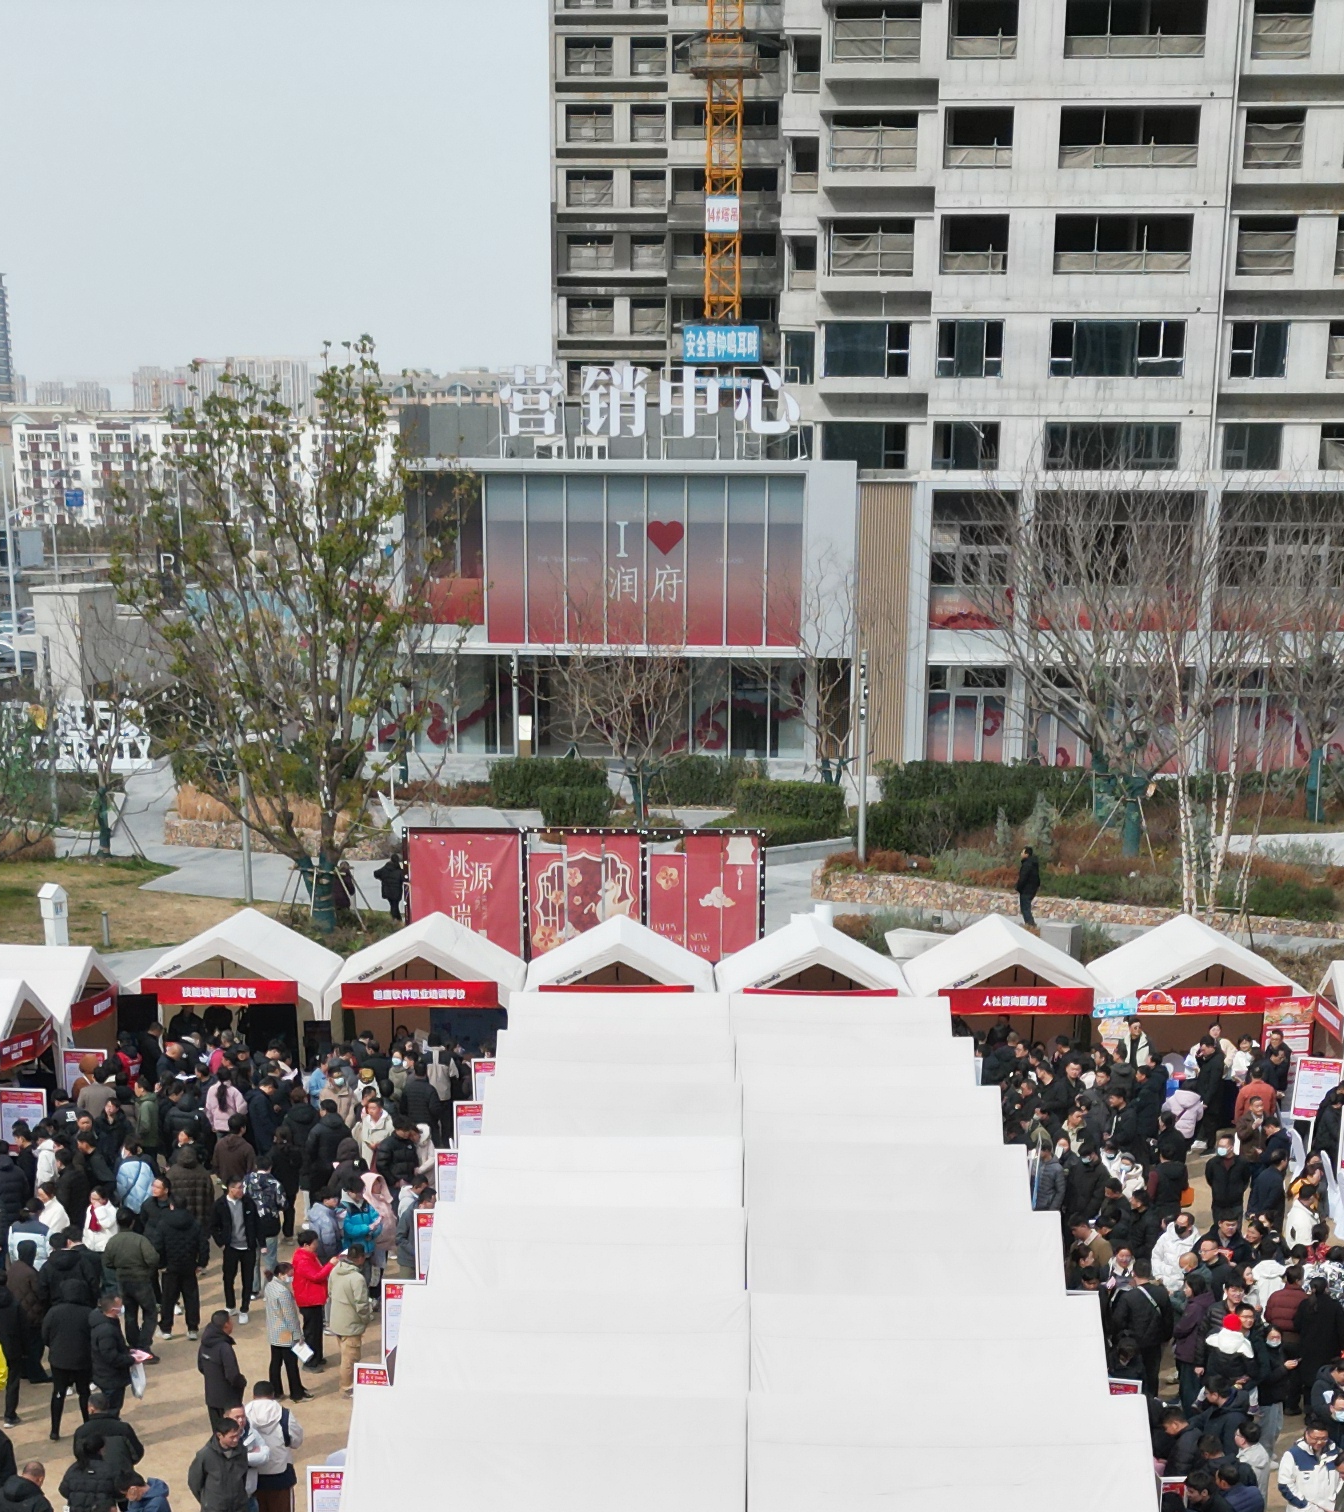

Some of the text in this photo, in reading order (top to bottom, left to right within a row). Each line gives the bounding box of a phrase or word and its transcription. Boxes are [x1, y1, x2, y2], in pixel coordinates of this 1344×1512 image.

[685, 330, 758, 358] 安全警钟鸣耳畔
[499, 365, 800, 438] 营销中心
[607, 564, 685, 604] 润府
